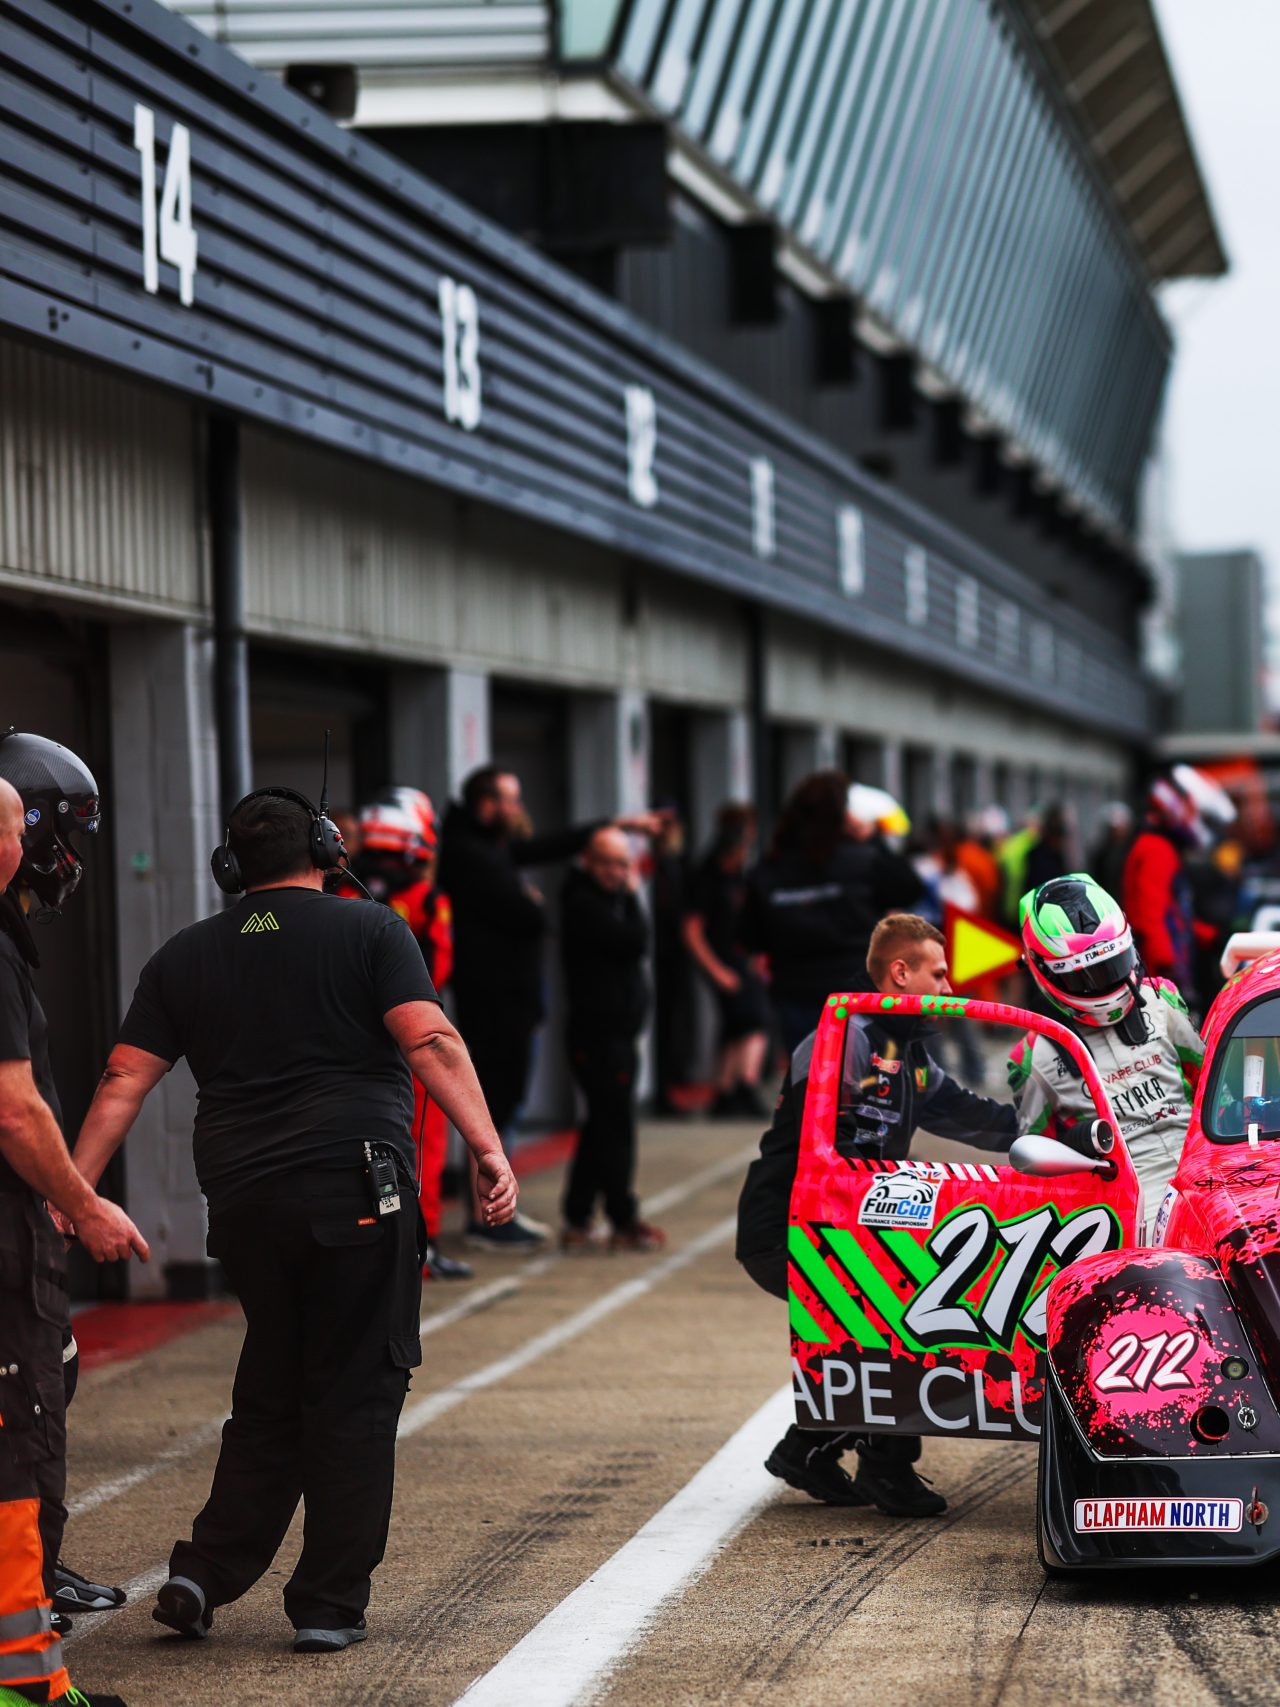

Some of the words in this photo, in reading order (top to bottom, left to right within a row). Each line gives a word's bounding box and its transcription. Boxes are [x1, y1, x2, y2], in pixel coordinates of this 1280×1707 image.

[134, 103, 198, 307] 14
[1102, 1066, 1133, 1085] VAPE
[1134, 1054, 1163, 1072] CLUB
[1113, 1076, 1166, 1119] TYRKR
[863, 1198, 932, 1219] FunCup
[904, 1209, 1111, 1339] 212
[1095, 1330, 1198, 1393] 212
[1083, 1502, 1166, 1527] CLAPHAM
[1169, 1502, 1230, 1527] NORTH
